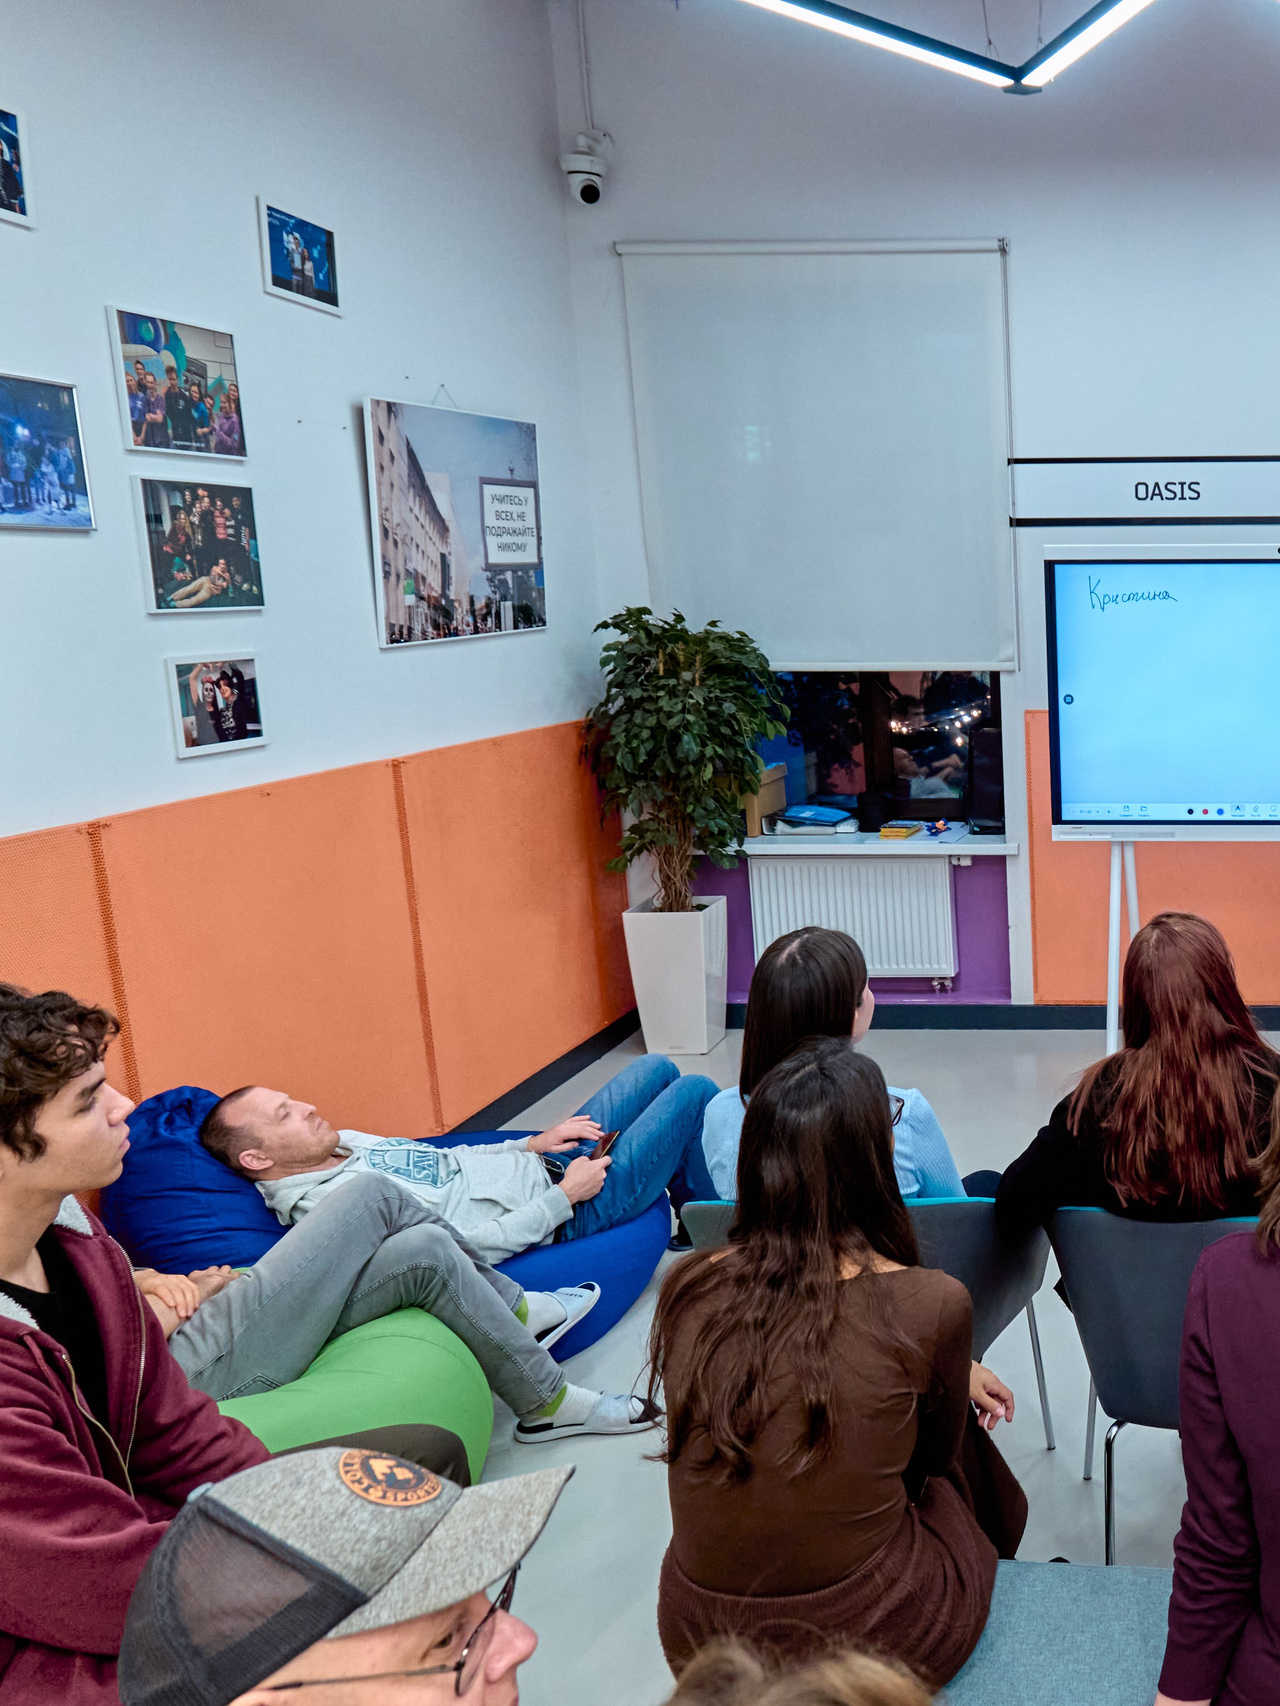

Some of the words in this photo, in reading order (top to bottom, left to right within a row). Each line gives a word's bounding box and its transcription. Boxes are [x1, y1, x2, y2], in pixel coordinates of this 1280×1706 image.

[1134, 481, 1201, 501] OASIS
[490, 493, 523, 506] УЧИТЕСЬ
[523, 496, 529, 506] У
[494, 510, 516, 523] ВСЕХ,
[516, 511, 526, 522] НЕ
[485, 525, 535, 538] ПОДРАЖАЙТЕ
[497, 542, 528, 553] НИКОМУ
[1088, 575, 1178, 612] Кристина
